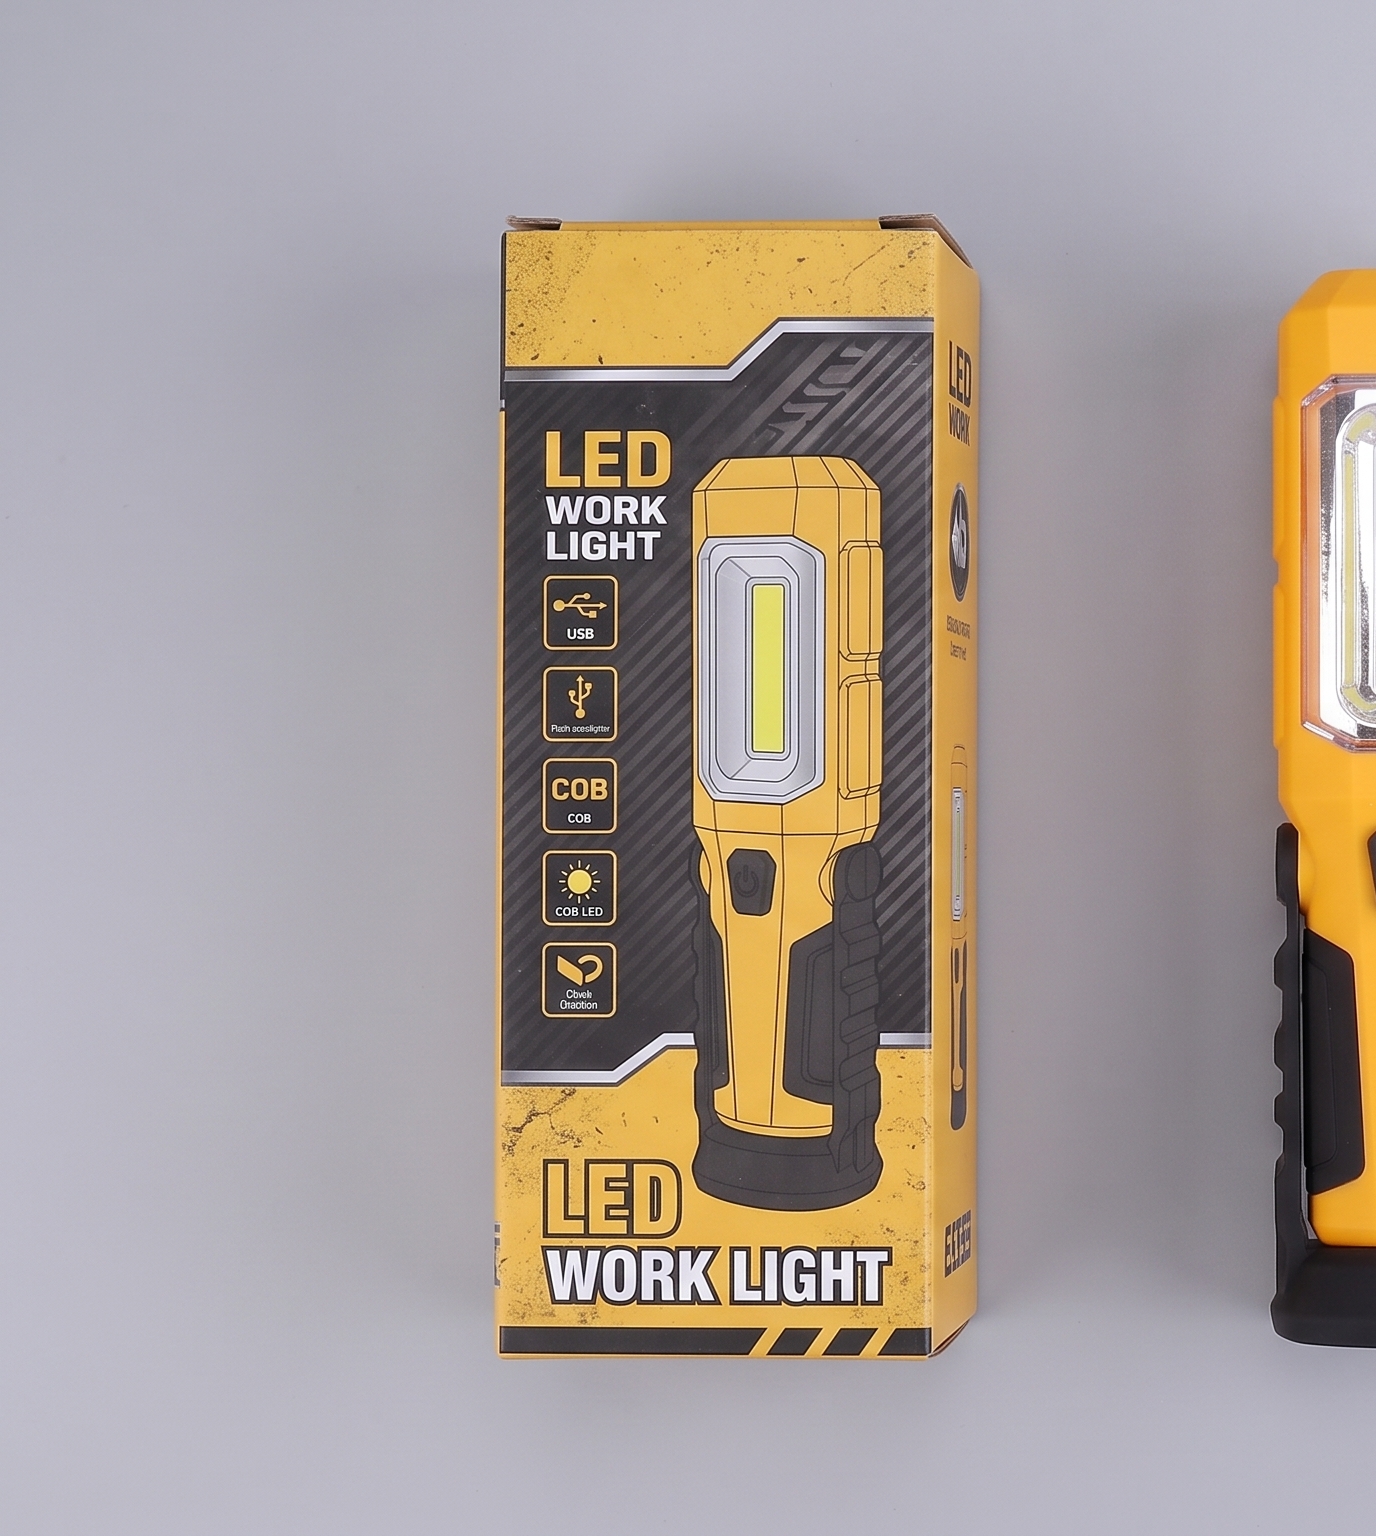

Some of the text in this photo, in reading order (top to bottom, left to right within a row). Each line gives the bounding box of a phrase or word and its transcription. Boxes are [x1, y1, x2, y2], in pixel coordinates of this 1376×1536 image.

[949, 340, 972, 408] LED
[948, 402, 971, 446] WORK
[545, 430, 672, 488] LED
[545, 495, 668, 525] WORK
[546, 531, 661, 561] LIGHT
[566, 628, 595, 640] USB
[551, 778, 608, 801] COB
[567, 813, 592, 824] COB
[555, 907, 603, 917] COB LED
[542, 1158, 683, 1239] LED
[541, 1246, 893, 1305] WORK LIGHT
